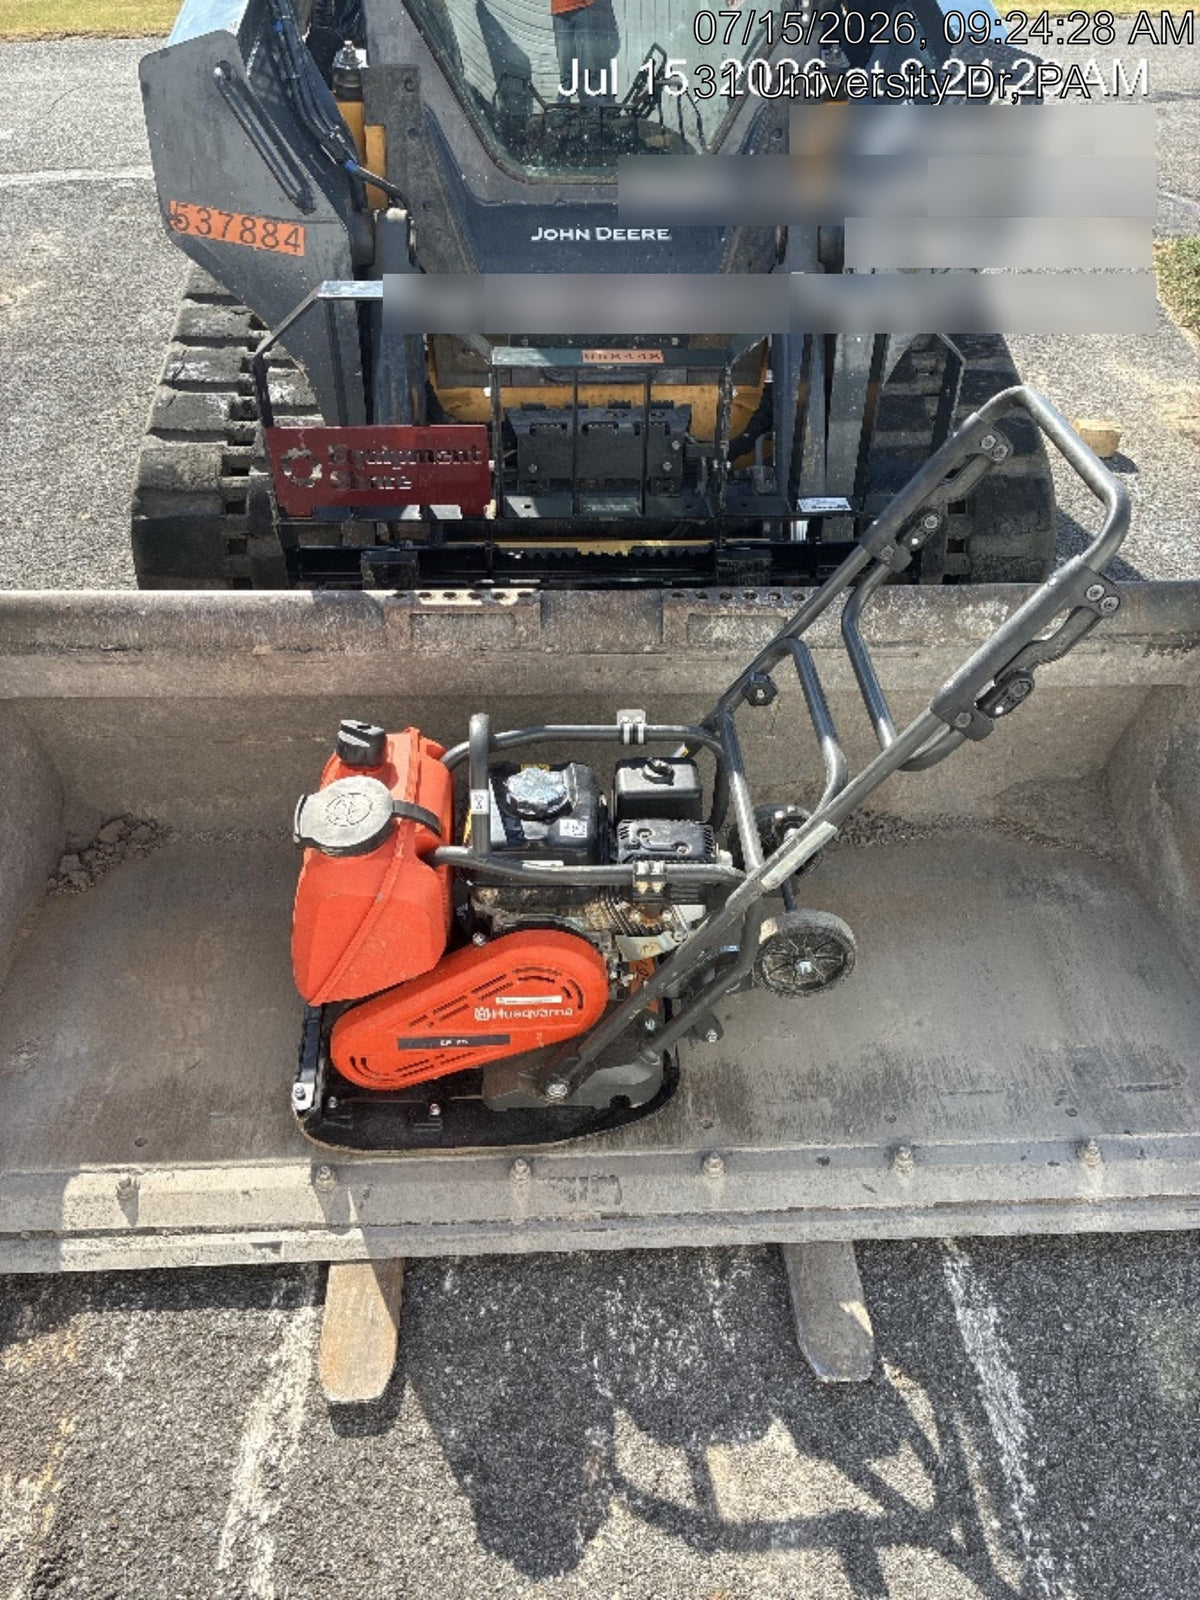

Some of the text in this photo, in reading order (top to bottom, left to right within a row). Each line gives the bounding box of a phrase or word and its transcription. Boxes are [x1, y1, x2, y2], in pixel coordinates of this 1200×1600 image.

[172, 203, 301, 252] 537884
[531, 226, 672, 241] JOHN DEERE
